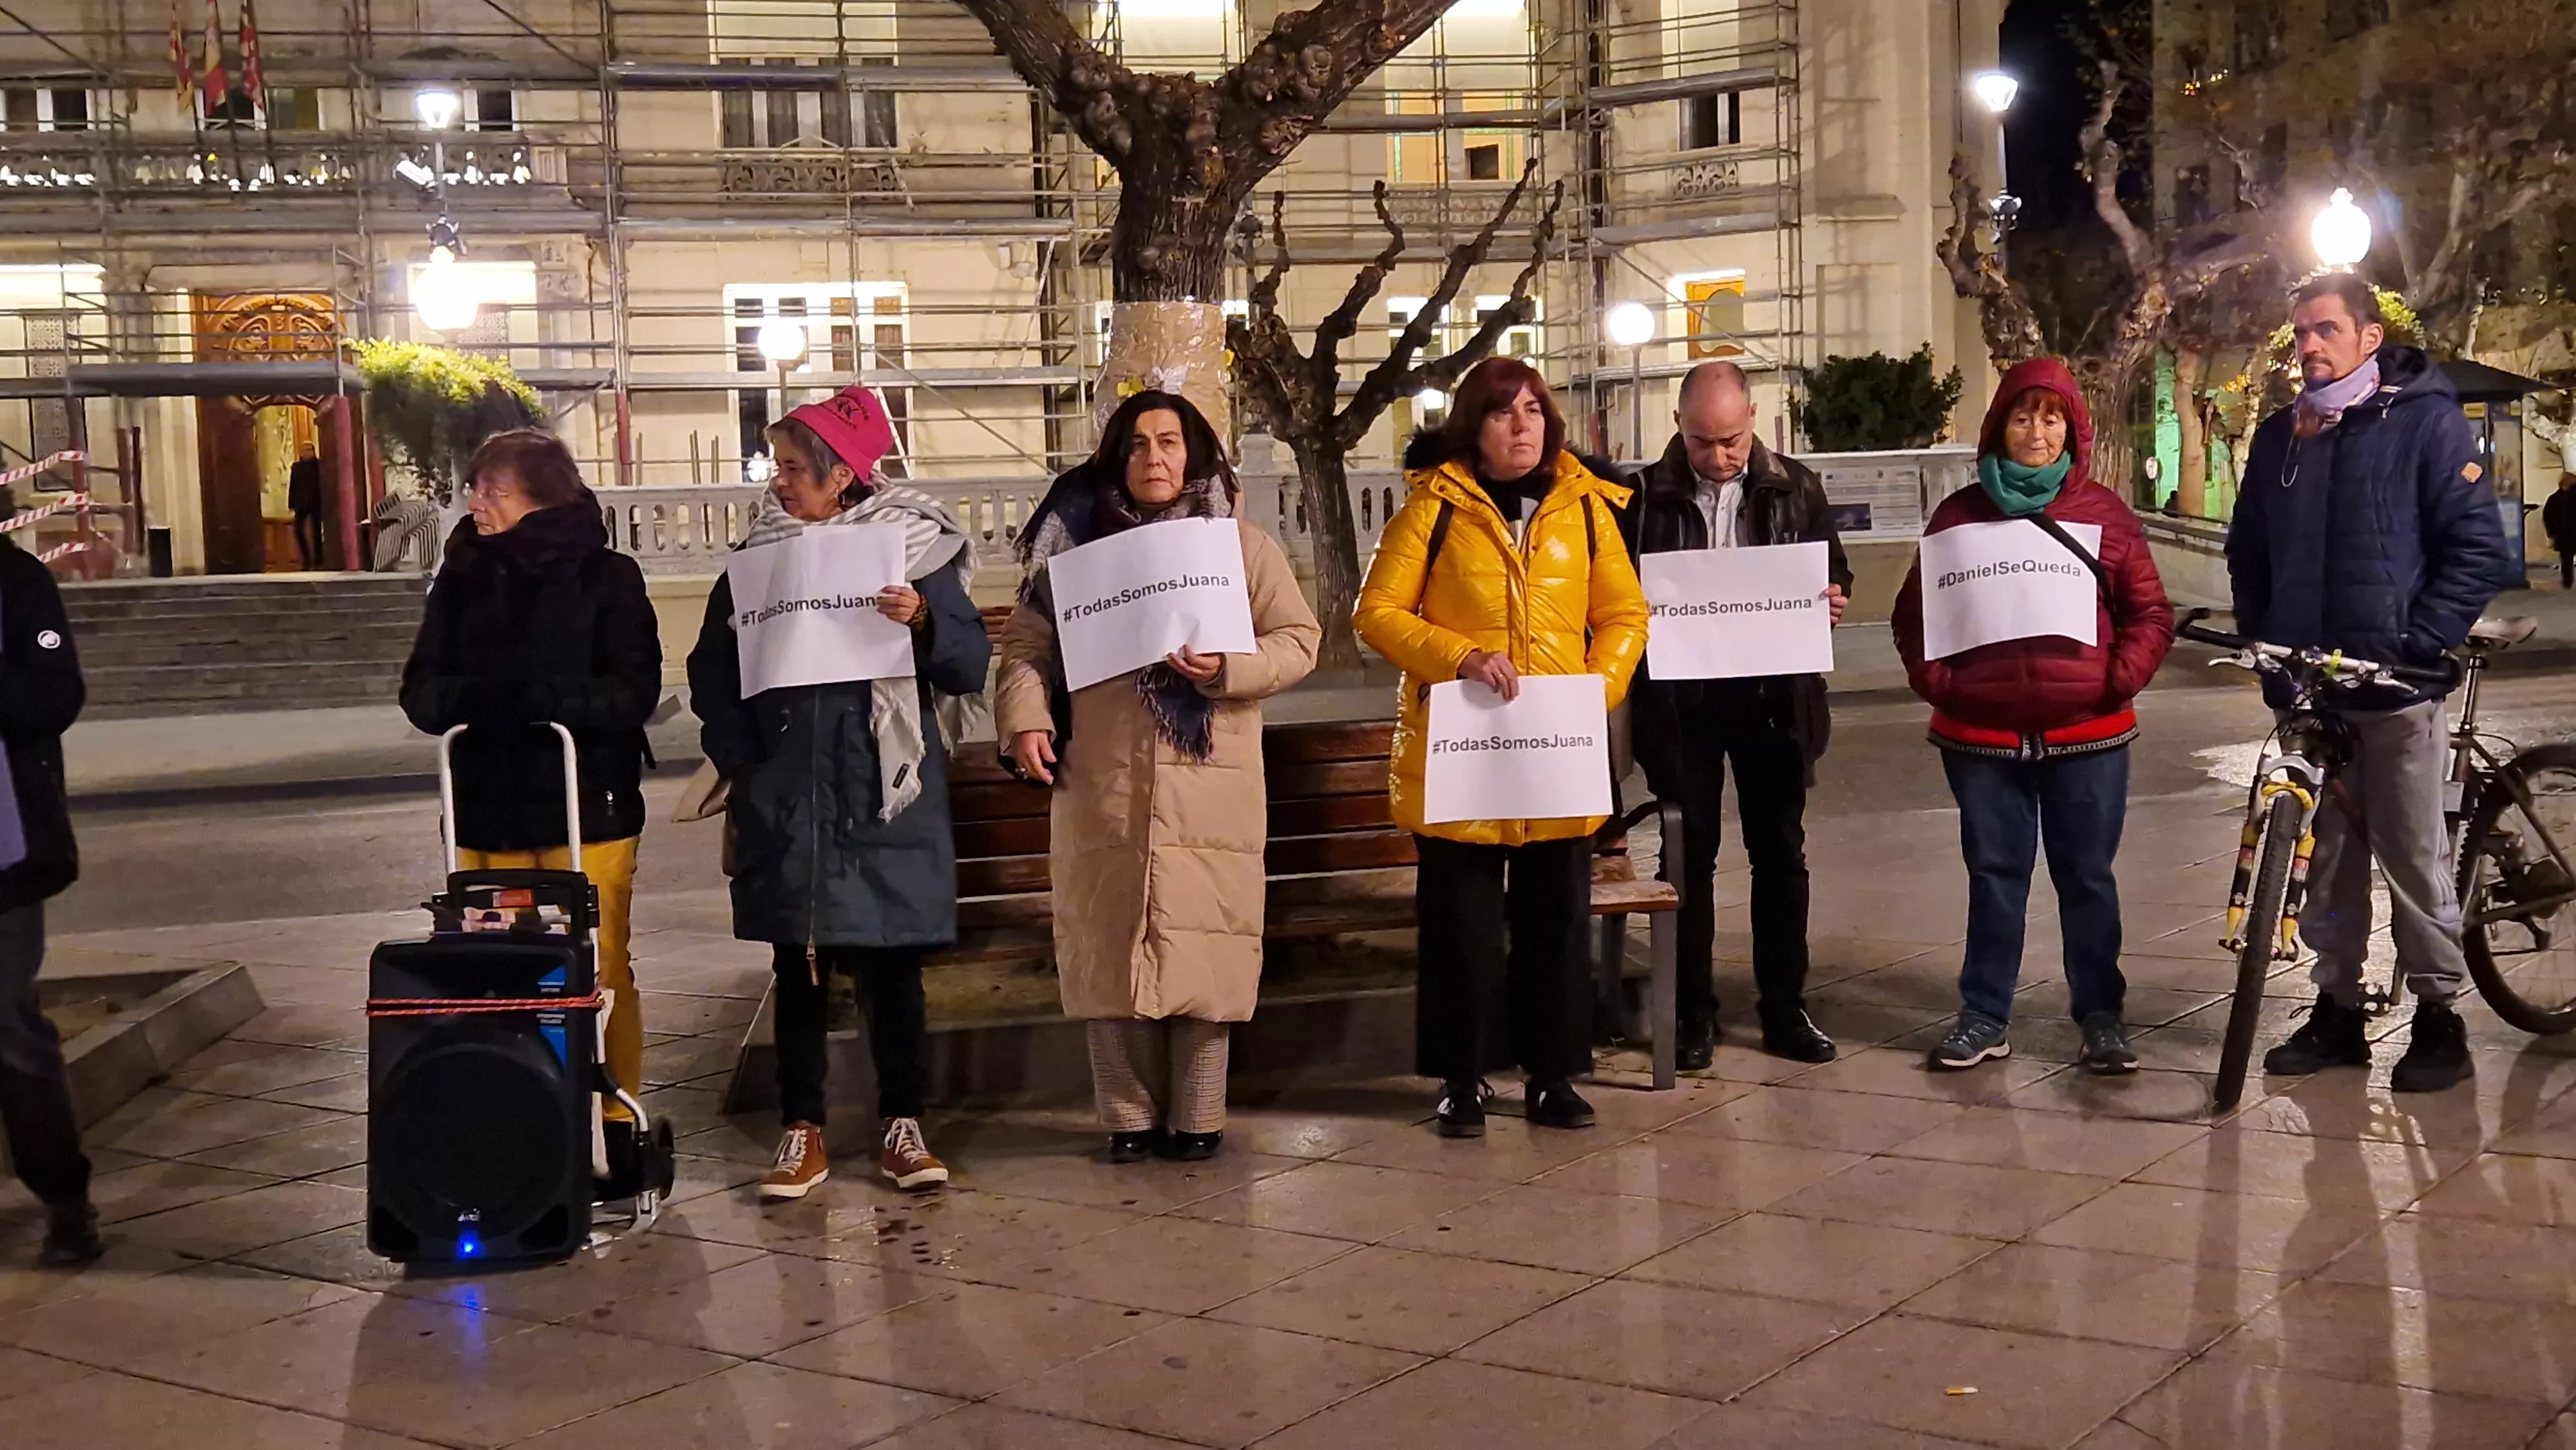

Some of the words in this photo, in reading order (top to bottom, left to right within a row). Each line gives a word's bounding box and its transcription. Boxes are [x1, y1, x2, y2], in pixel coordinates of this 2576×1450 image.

[1938, 560, 2081, 590] #DanielSeQueda
[741, 594, 881, 627] #TosSomosJuan
[1063, 574, 1229, 623] #TodasSomosJuana
[1651, 598, 1812, 617] #TodasSomosJuana
[1432, 734, 1593, 754] #TodasSomosJuana
